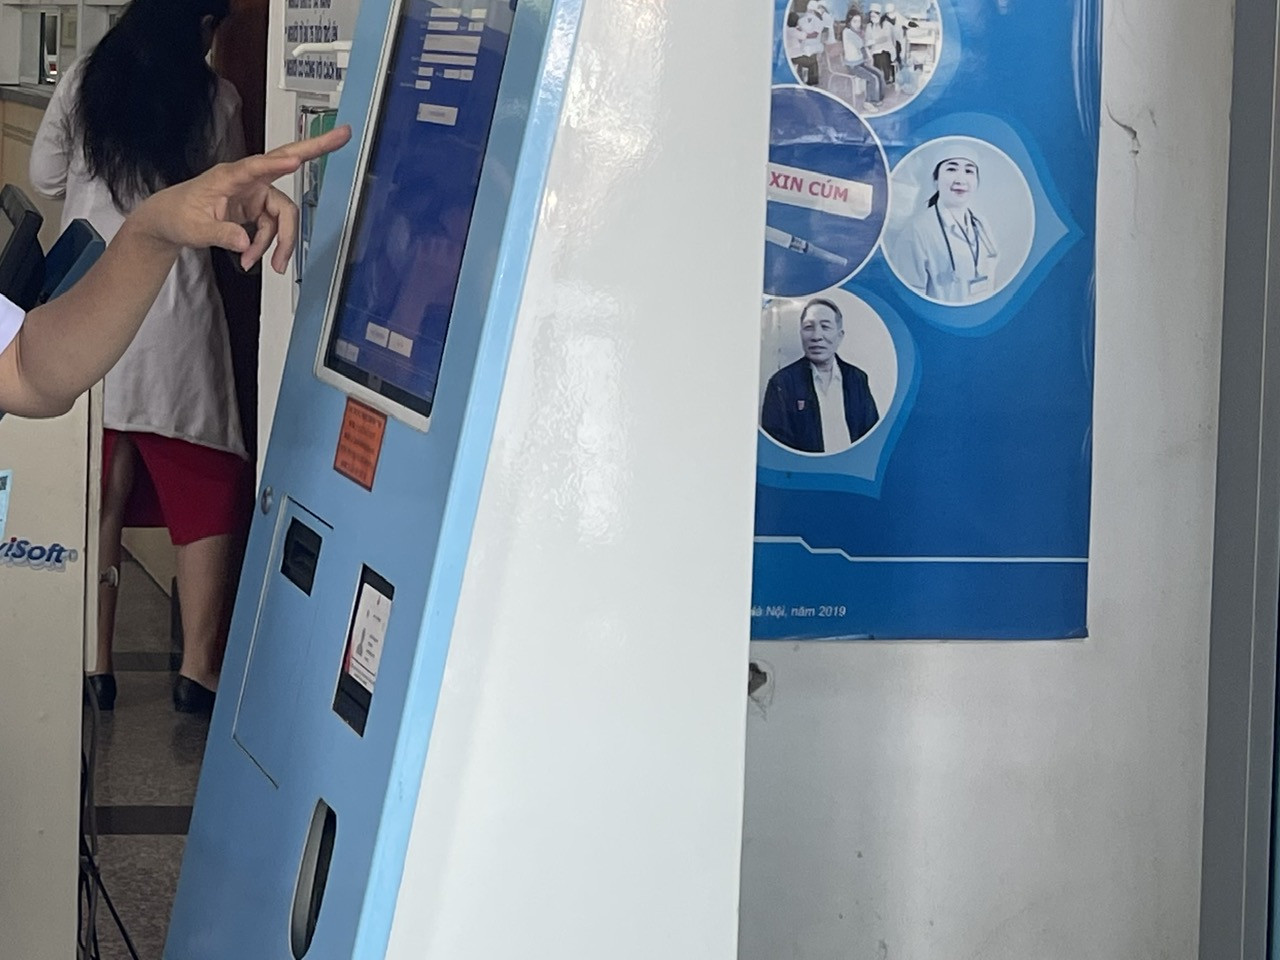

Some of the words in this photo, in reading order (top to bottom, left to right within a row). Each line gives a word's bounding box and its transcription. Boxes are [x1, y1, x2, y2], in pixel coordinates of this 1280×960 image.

[769, 171, 804, 192] XIN
[808, 179, 849, 202] CÚM
[790, 606, 816, 617] năm
[818, 605, 847, 617] 2019
